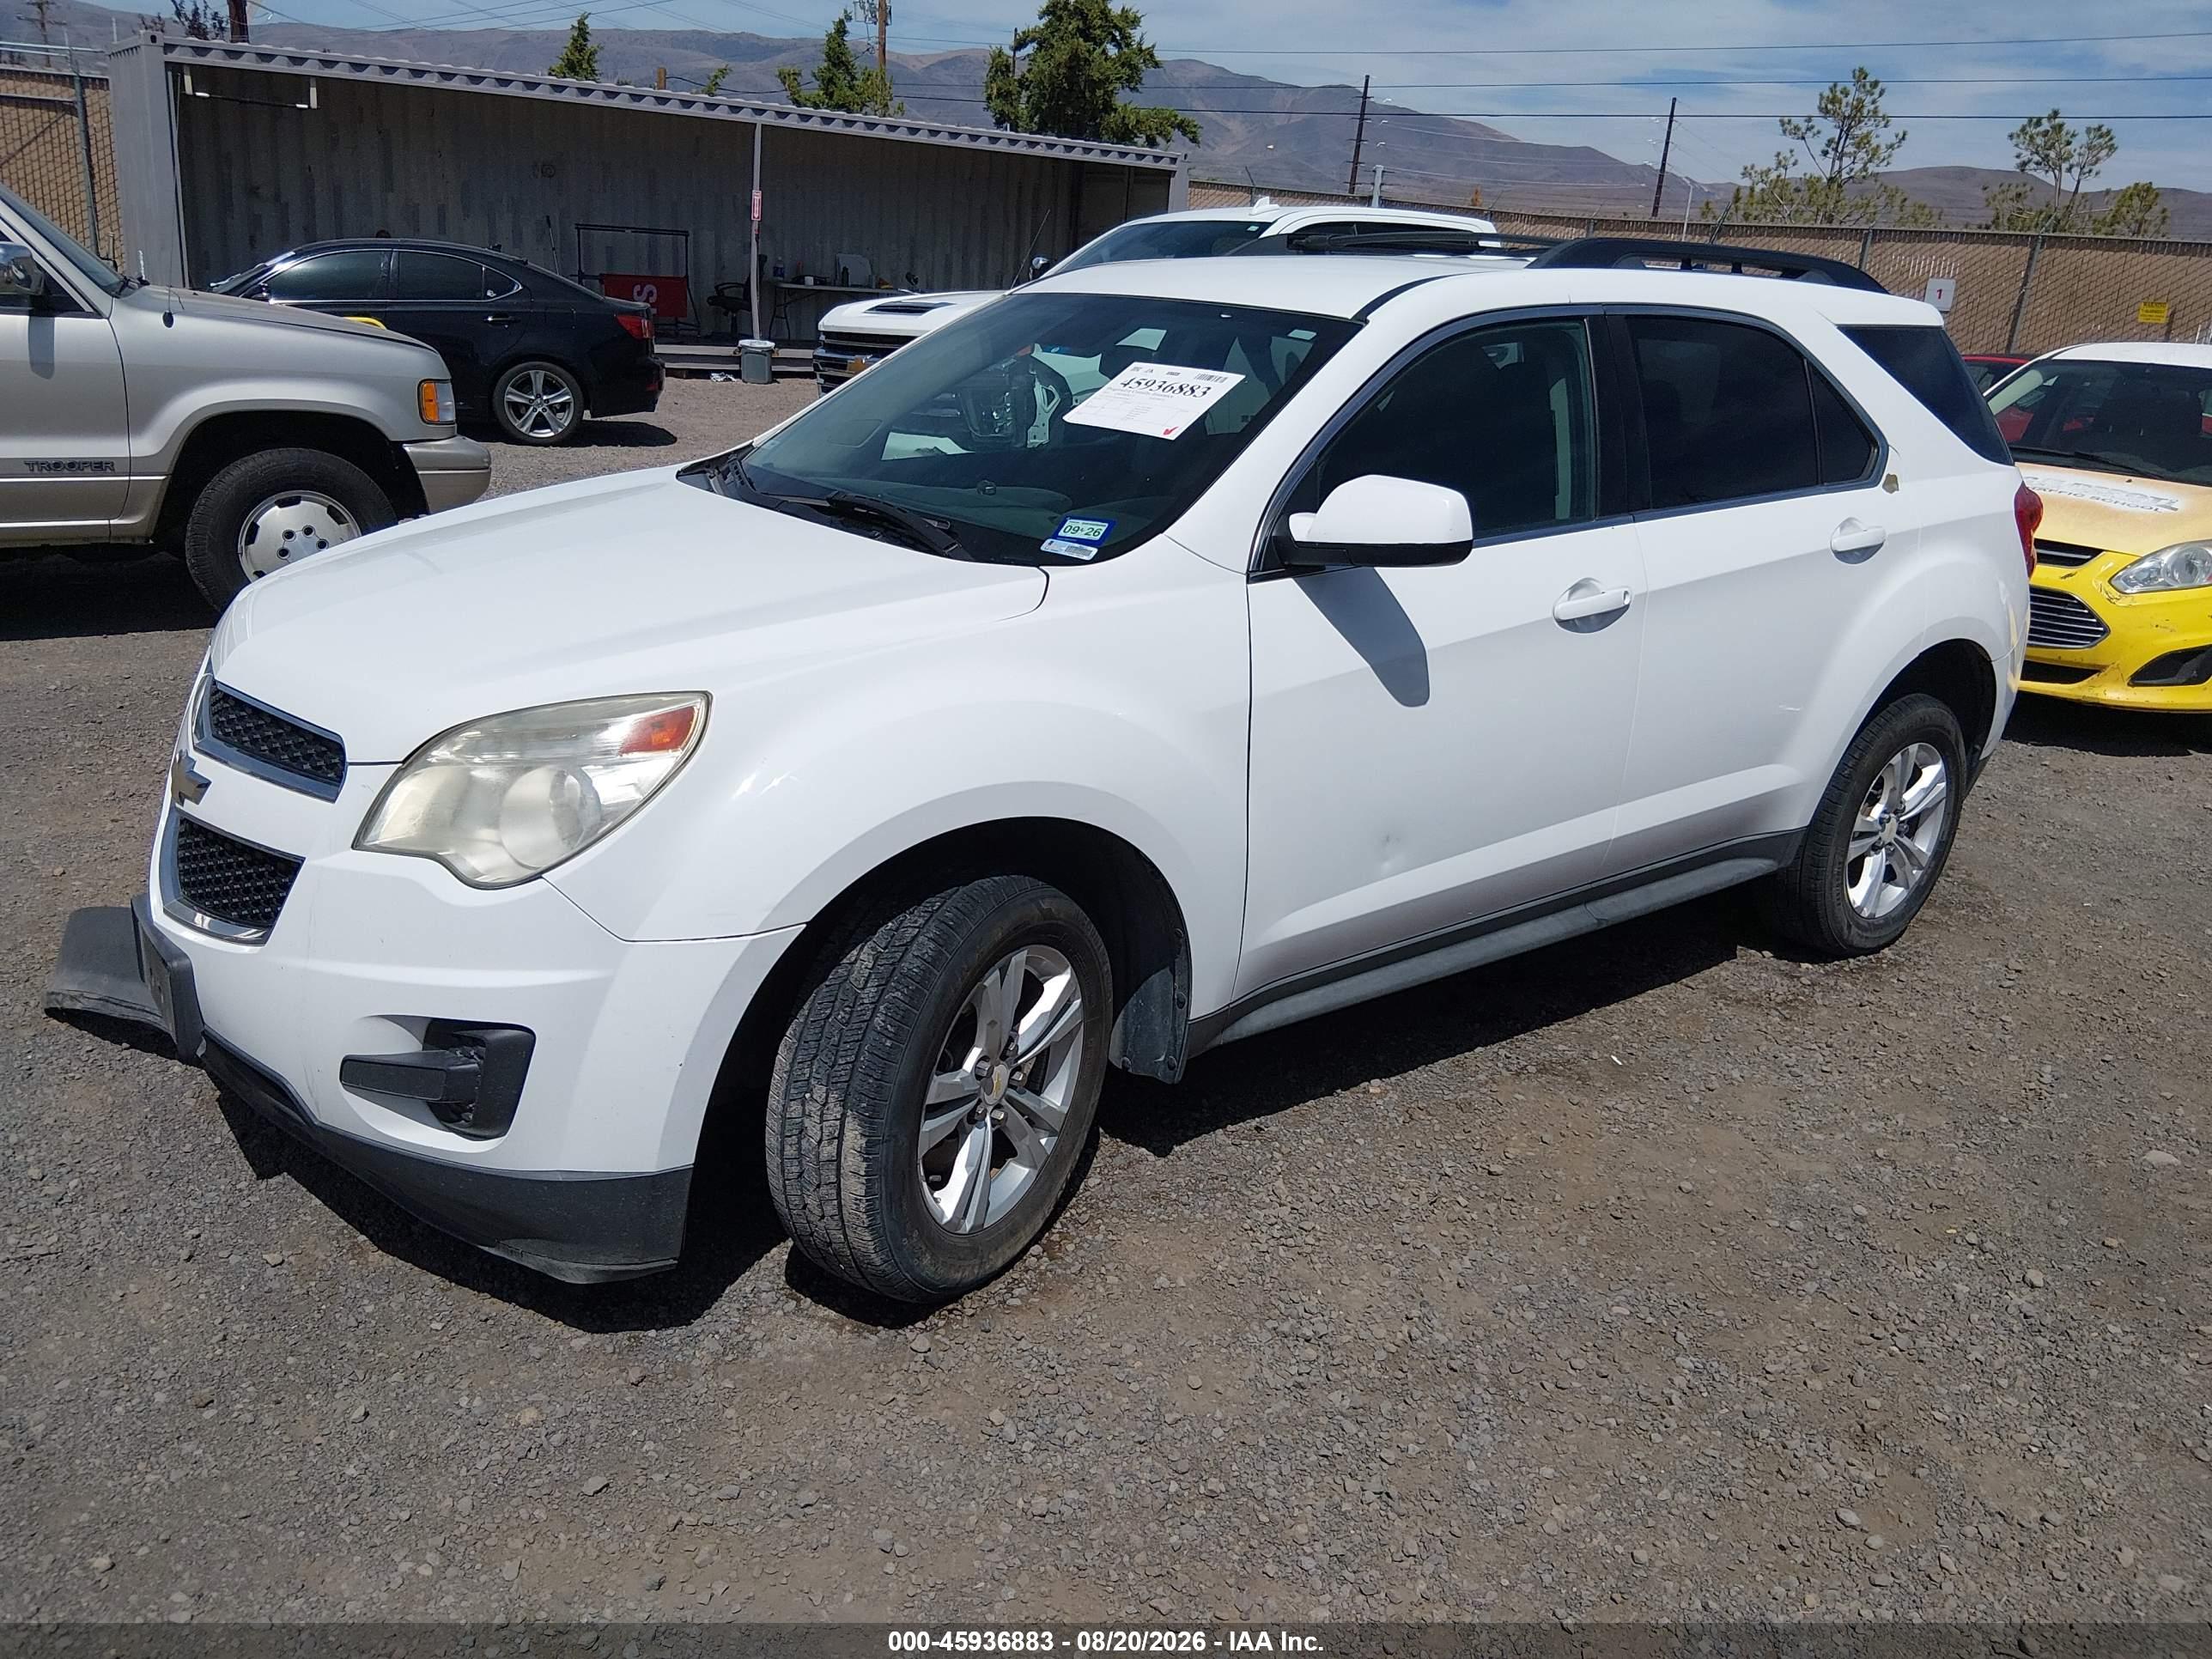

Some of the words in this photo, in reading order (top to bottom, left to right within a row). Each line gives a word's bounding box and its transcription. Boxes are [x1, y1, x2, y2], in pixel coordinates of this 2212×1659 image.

[1936, 289, 1943, 300] 1
[1120, 377, 1212, 398] 45936883
[24, 460, 116, 471] TROOPER
[2089, 495, 2163, 514] SCHOOL
